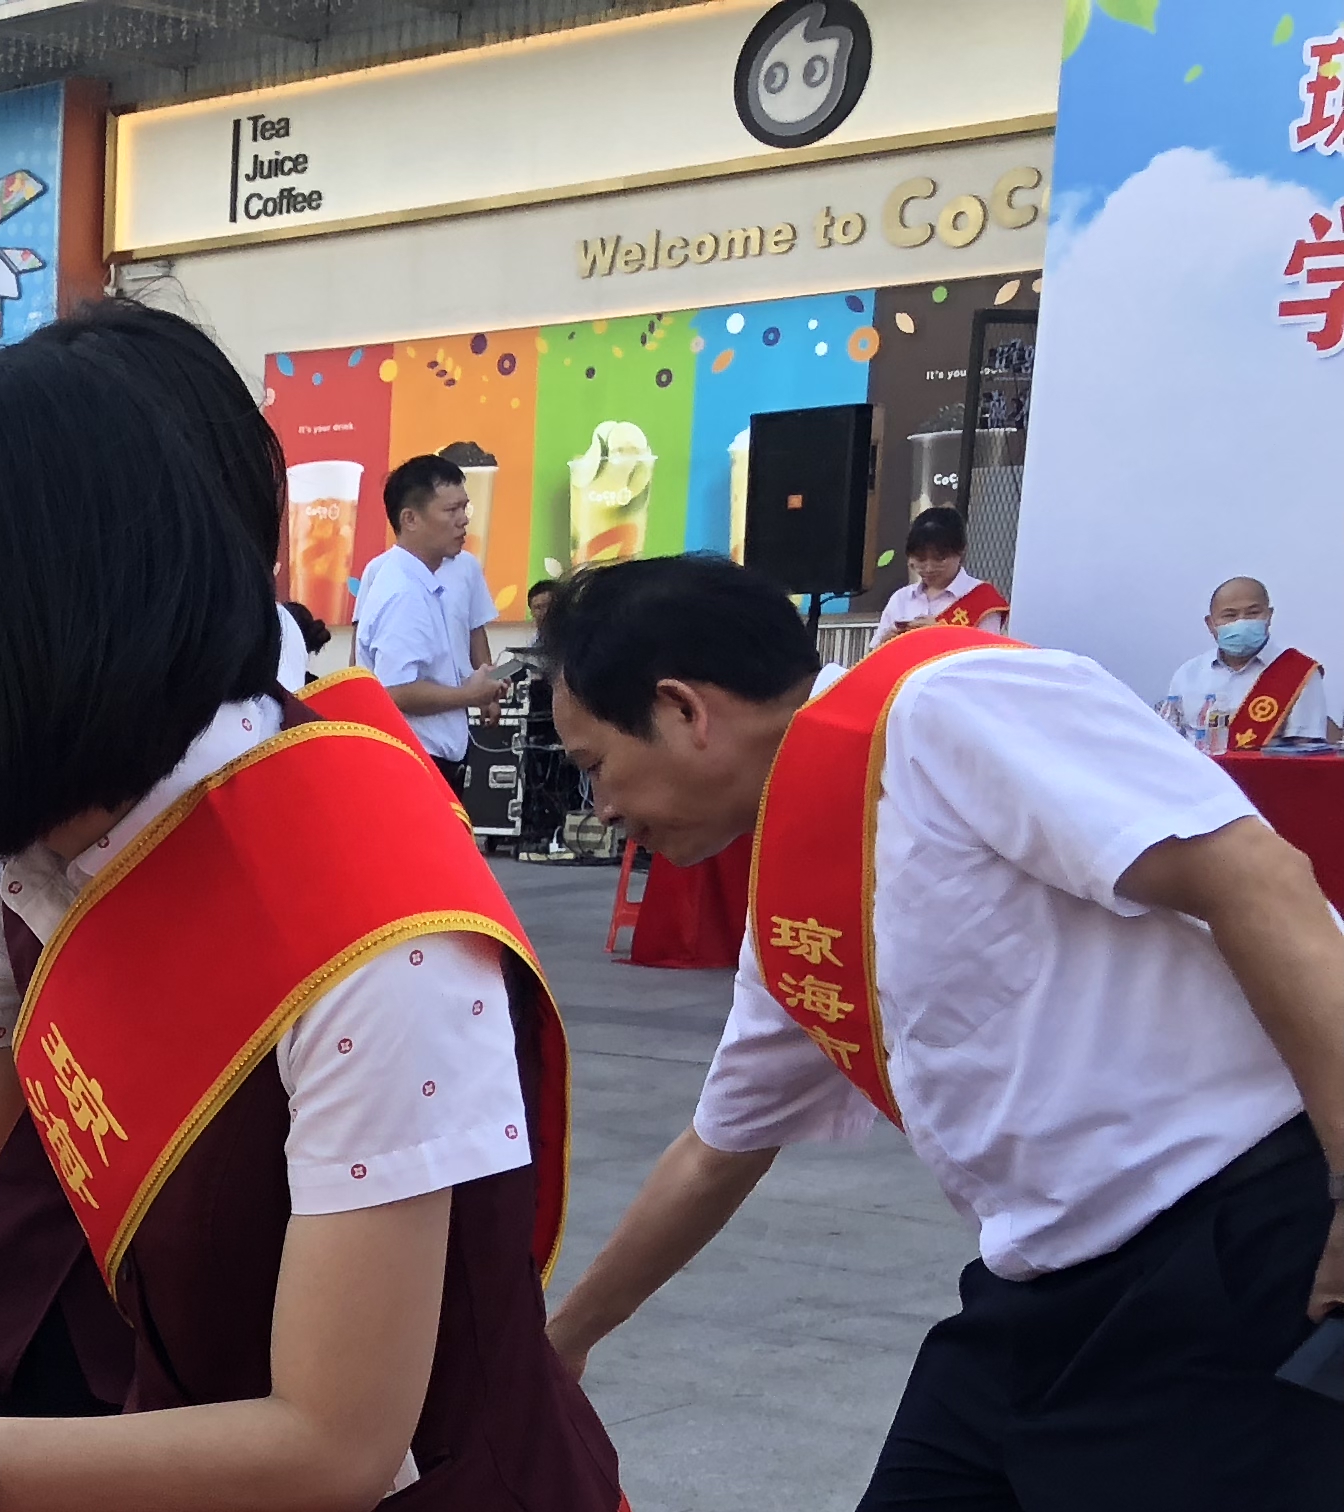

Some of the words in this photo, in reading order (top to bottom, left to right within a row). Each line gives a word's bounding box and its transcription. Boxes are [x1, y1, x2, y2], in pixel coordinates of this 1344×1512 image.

[248, 113, 290, 143] Tea
[245, 150, 308, 184] Juice
[244, 186, 323, 222] Coffee
[576, 221, 797, 280] Welcome
[814, 205, 866, 249] to
[881, 165, 1050, 250] CoC
[946, 368, 969, 380] you
[933, 473, 959, 486] CoC
[25, 1021, 129, 1210] 琼海
